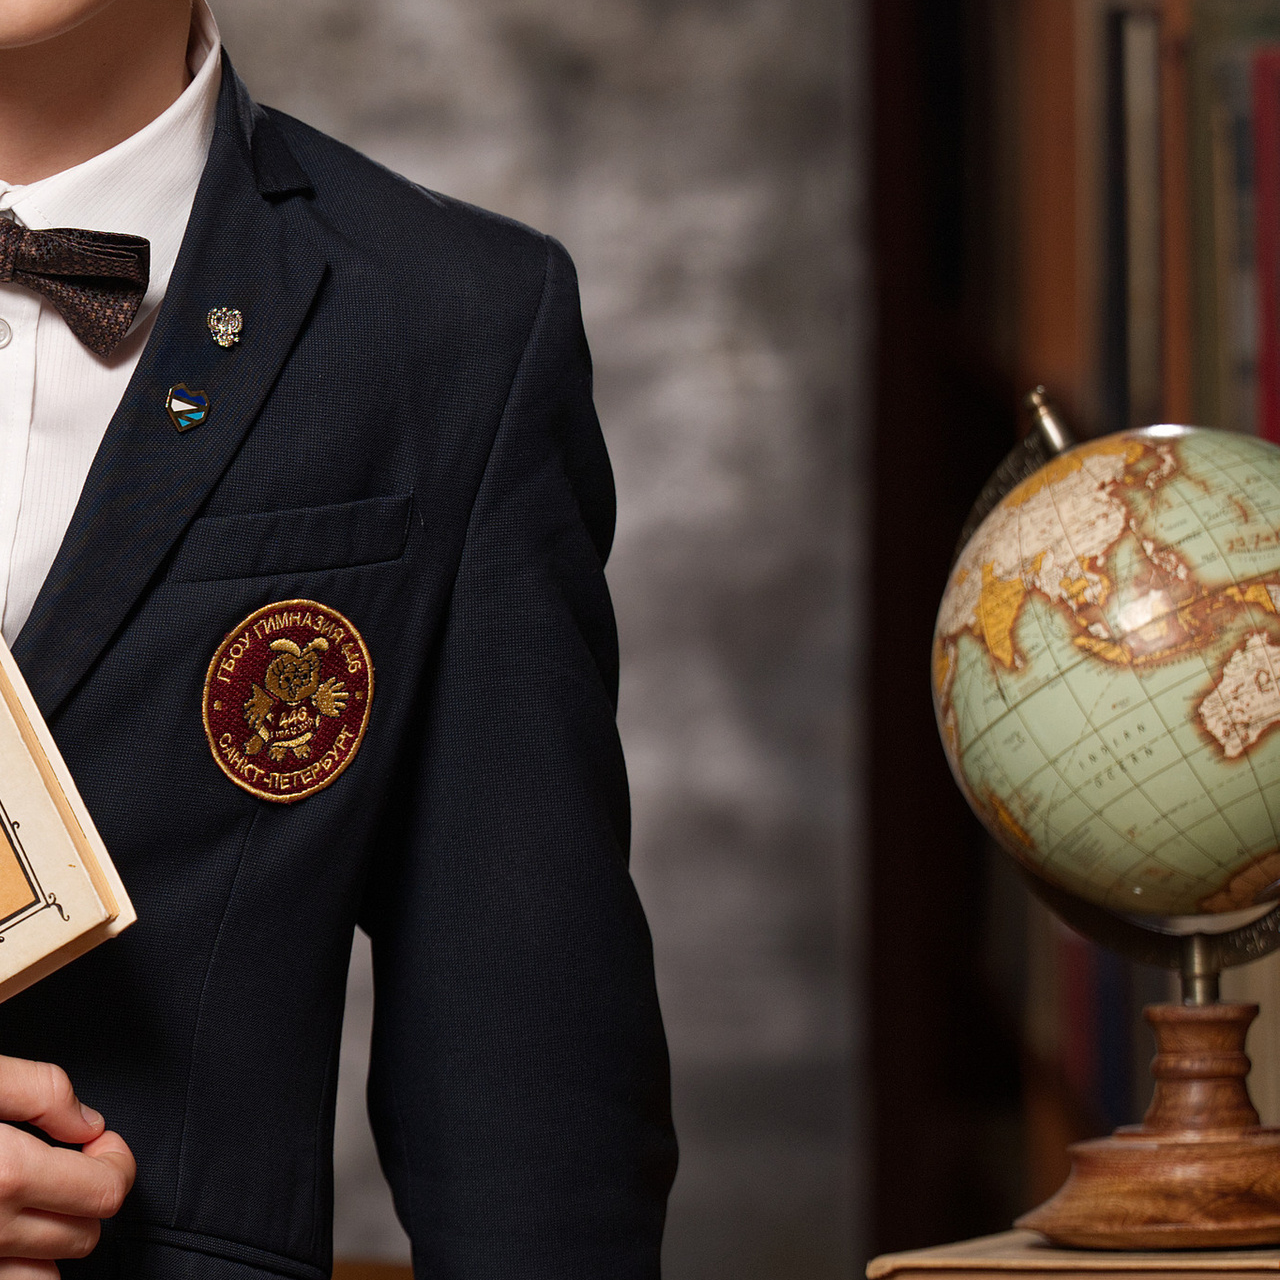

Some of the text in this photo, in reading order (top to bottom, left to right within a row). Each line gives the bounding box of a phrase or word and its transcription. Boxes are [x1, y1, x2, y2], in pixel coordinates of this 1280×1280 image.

[217, 632, 250, 682] ГБОУ
[253, 612, 345, 645] ГИМНАЗИЯ
[219, 724, 354, 790] САНКТ-ПЕТЕРБУРГ
